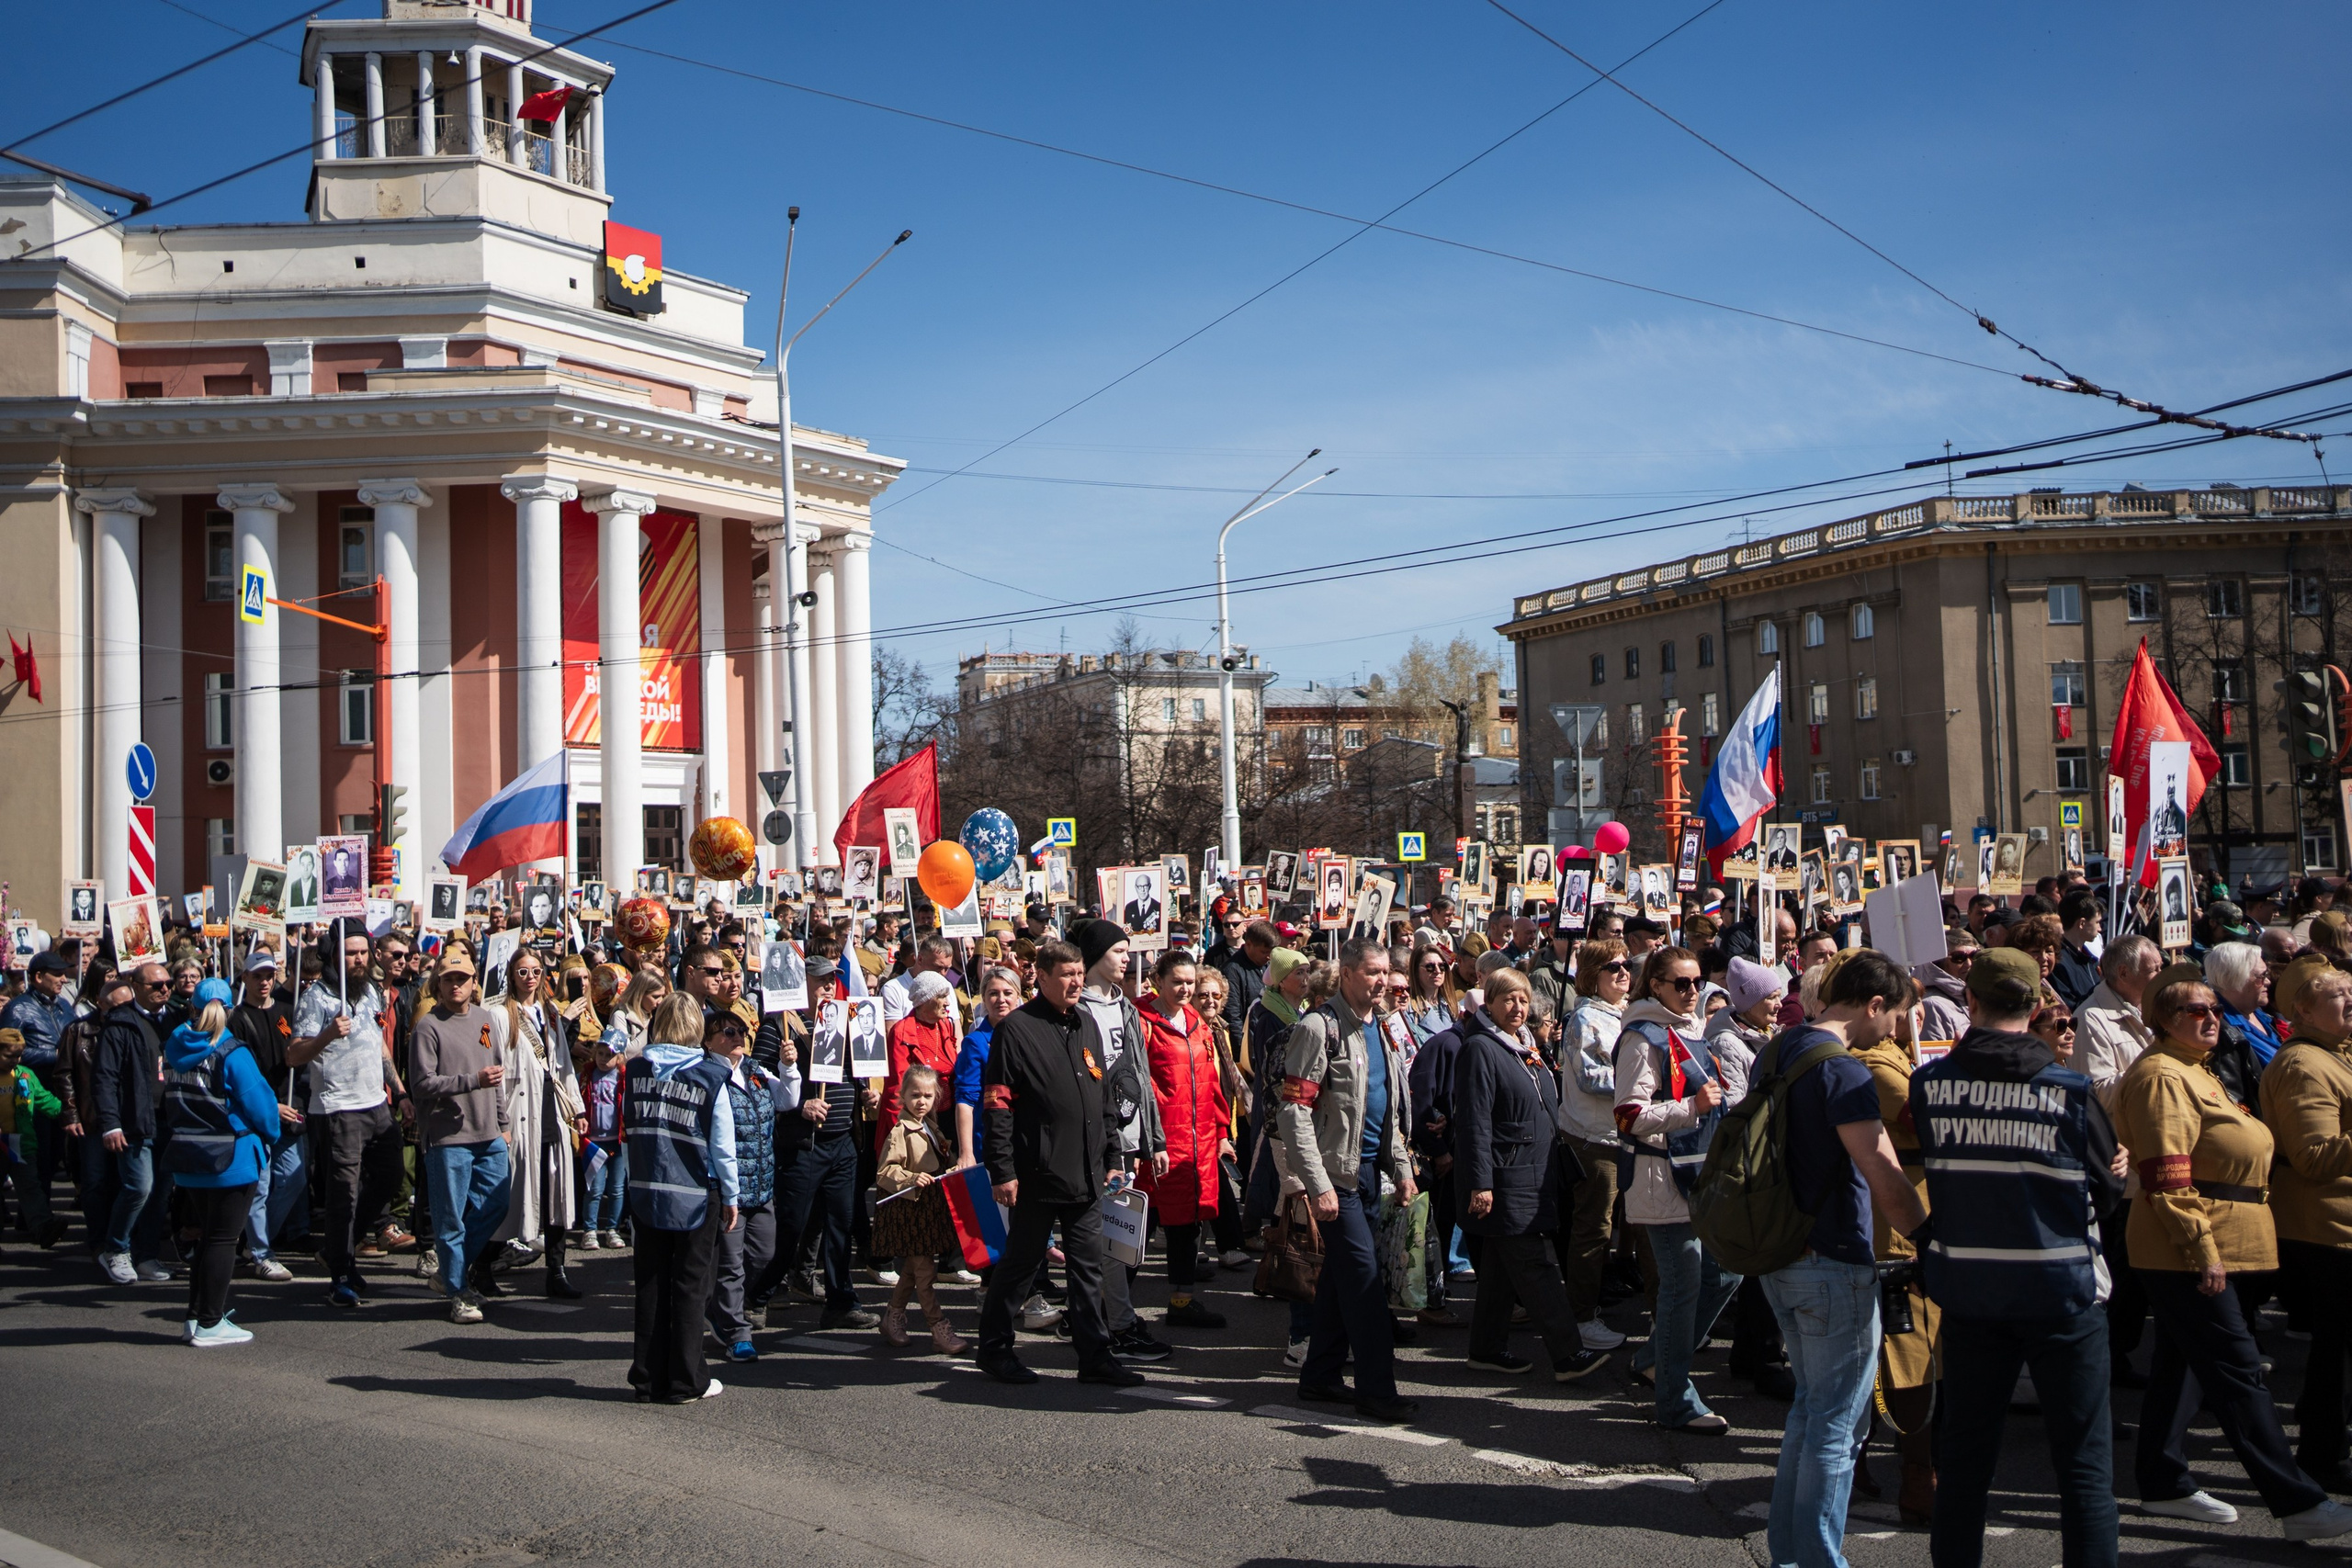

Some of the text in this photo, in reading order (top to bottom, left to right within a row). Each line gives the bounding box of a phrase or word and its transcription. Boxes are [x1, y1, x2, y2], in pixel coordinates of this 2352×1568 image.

[1802, 811, 1818, 823] ВТБ
[1924, 1079, 2066, 1115] НАРОДНЫЙ
[1102, 1213, 1136, 1235] Ветера
